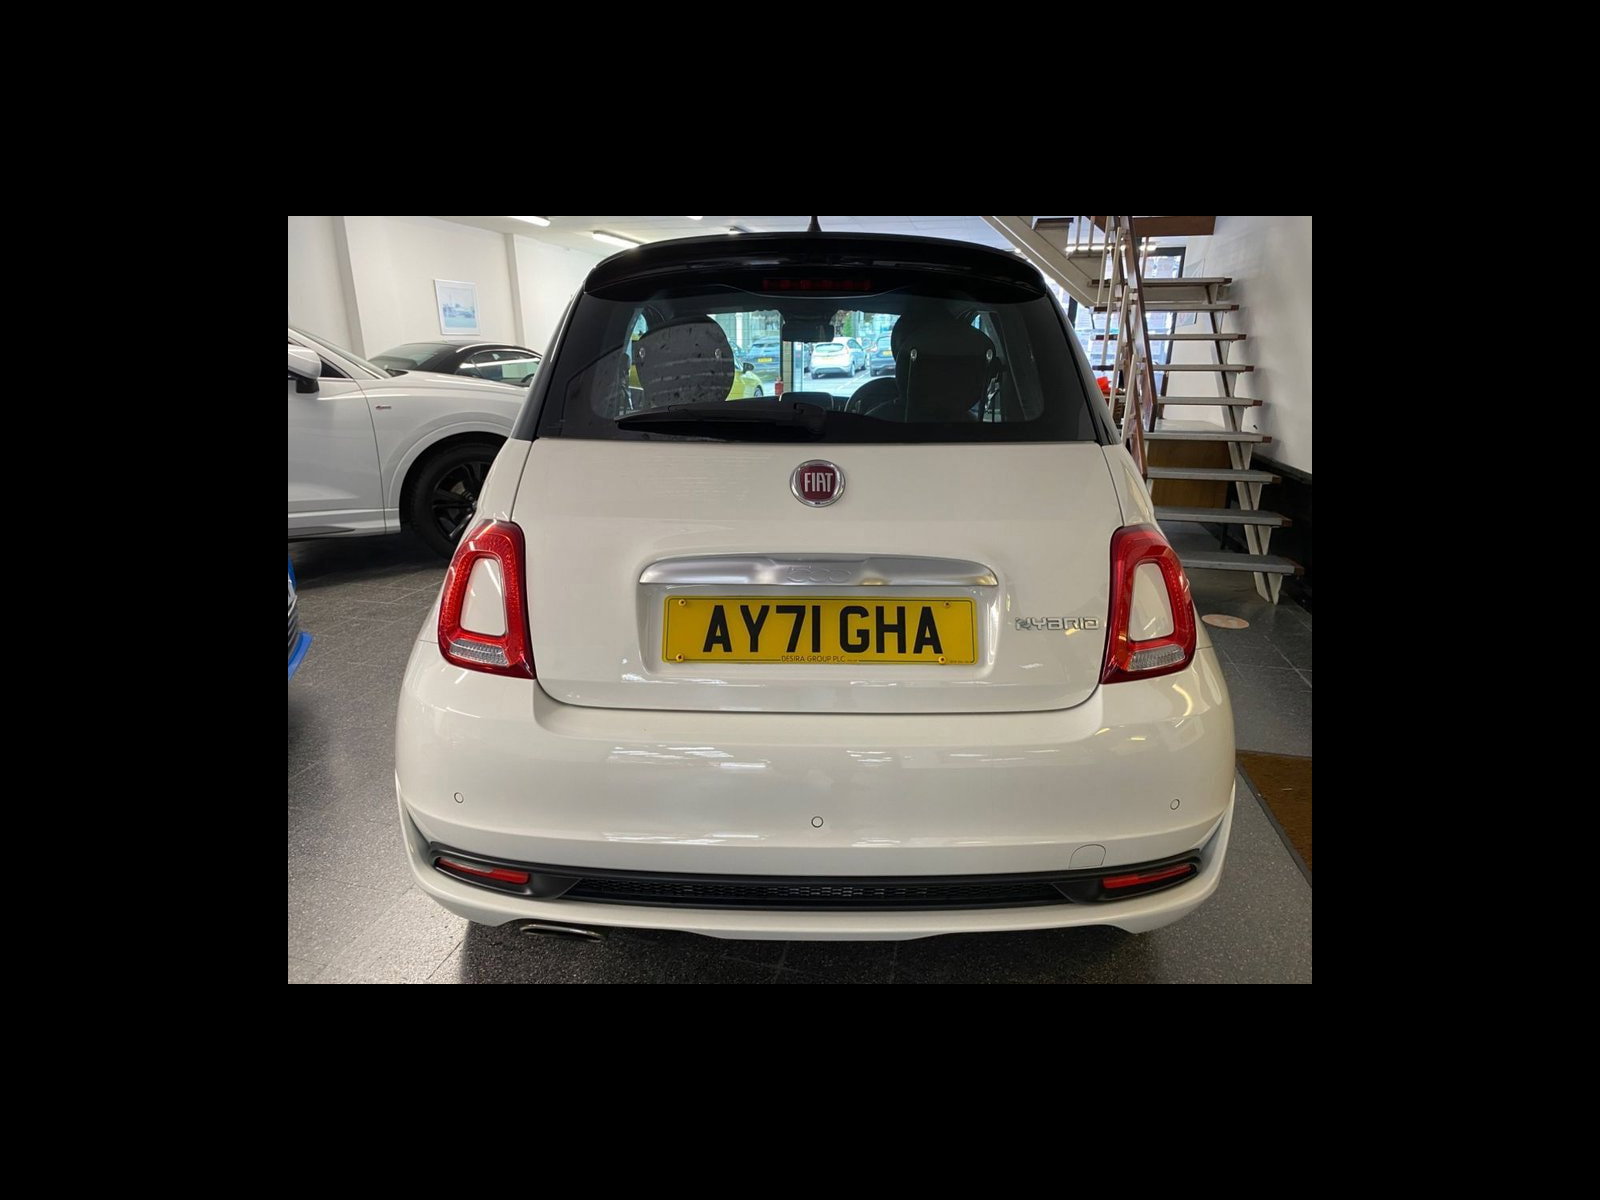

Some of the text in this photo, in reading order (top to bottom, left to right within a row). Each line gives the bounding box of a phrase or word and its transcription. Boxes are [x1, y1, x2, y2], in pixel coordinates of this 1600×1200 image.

[804, 472, 834, 492] FIAT
[703, 604, 943, 654] AY71 GHA
[1015, 616, 1099, 630] HYBRID
[781, 655, 805, 663] DESIRA
[807, 655, 831, 663] GROUP
[832, 655, 846, 663] PLC
